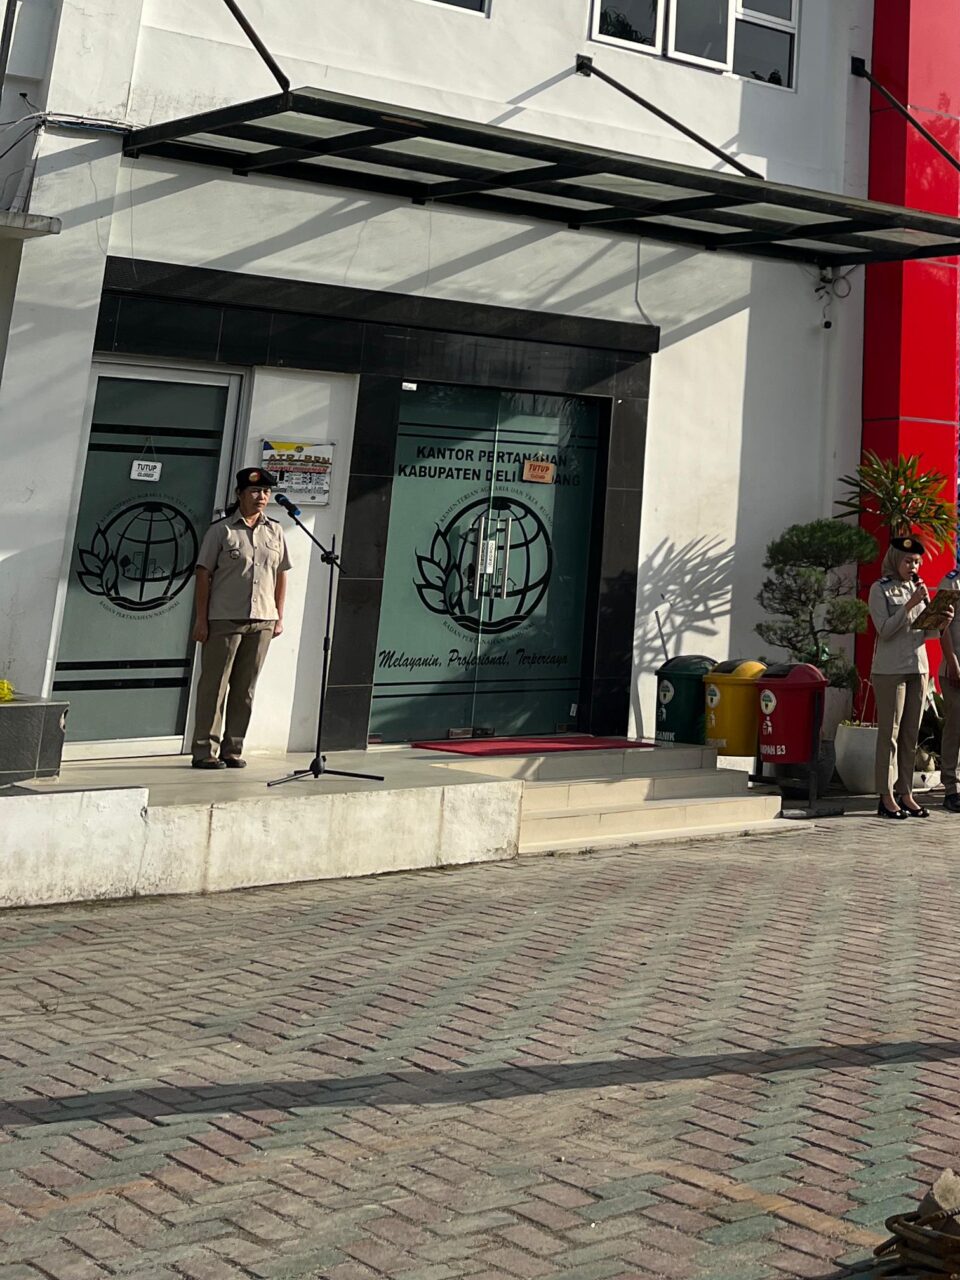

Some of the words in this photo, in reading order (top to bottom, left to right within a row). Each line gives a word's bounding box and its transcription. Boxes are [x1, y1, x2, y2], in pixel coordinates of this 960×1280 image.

[417, 446, 474, 461] KANTOR
[138, 463, 157, 472] TUTUP
[529, 464, 550, 473] TUTUP
[398, 464, 480, 481] KABUPATEN
[485, 468, 516, 482] DELI
[481, 485, 509, 493] AGARIA
